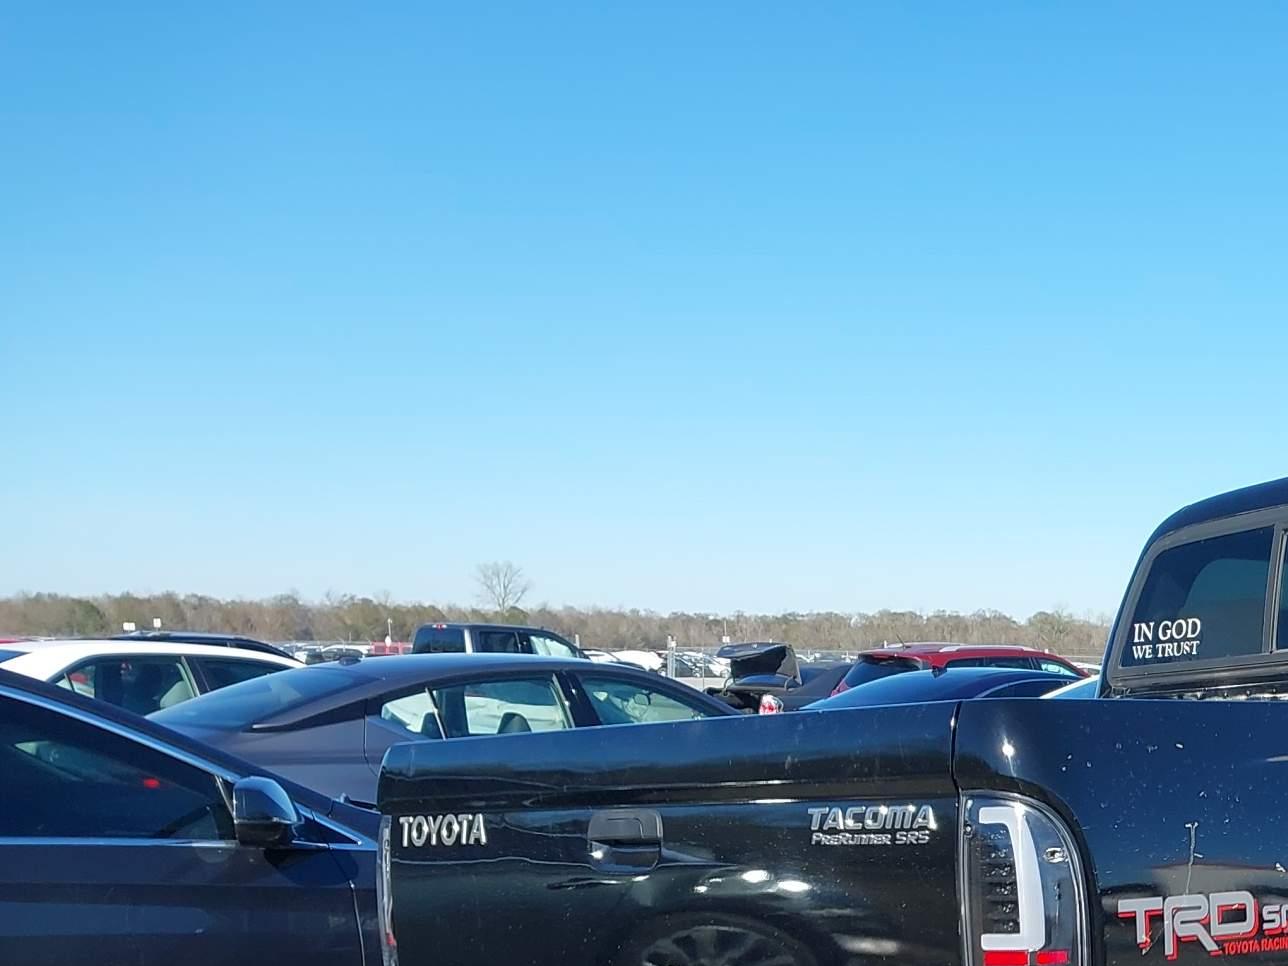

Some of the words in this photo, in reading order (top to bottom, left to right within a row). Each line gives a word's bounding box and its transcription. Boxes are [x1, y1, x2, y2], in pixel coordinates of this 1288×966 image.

[1134, 621, 1155, 643] IN
[1158, 618, 1201, 641] GOD
[1132, 644, 1153, 660] WE
[1156, 640, 1200, 658] TRUST
[399, 813, 487, 848] TOYOTA
[807, 804, 938, 831] TACOMA
[1117, 890, 1259, 960] TRD
[1223, 940, 1260, 956] TOYOTA
